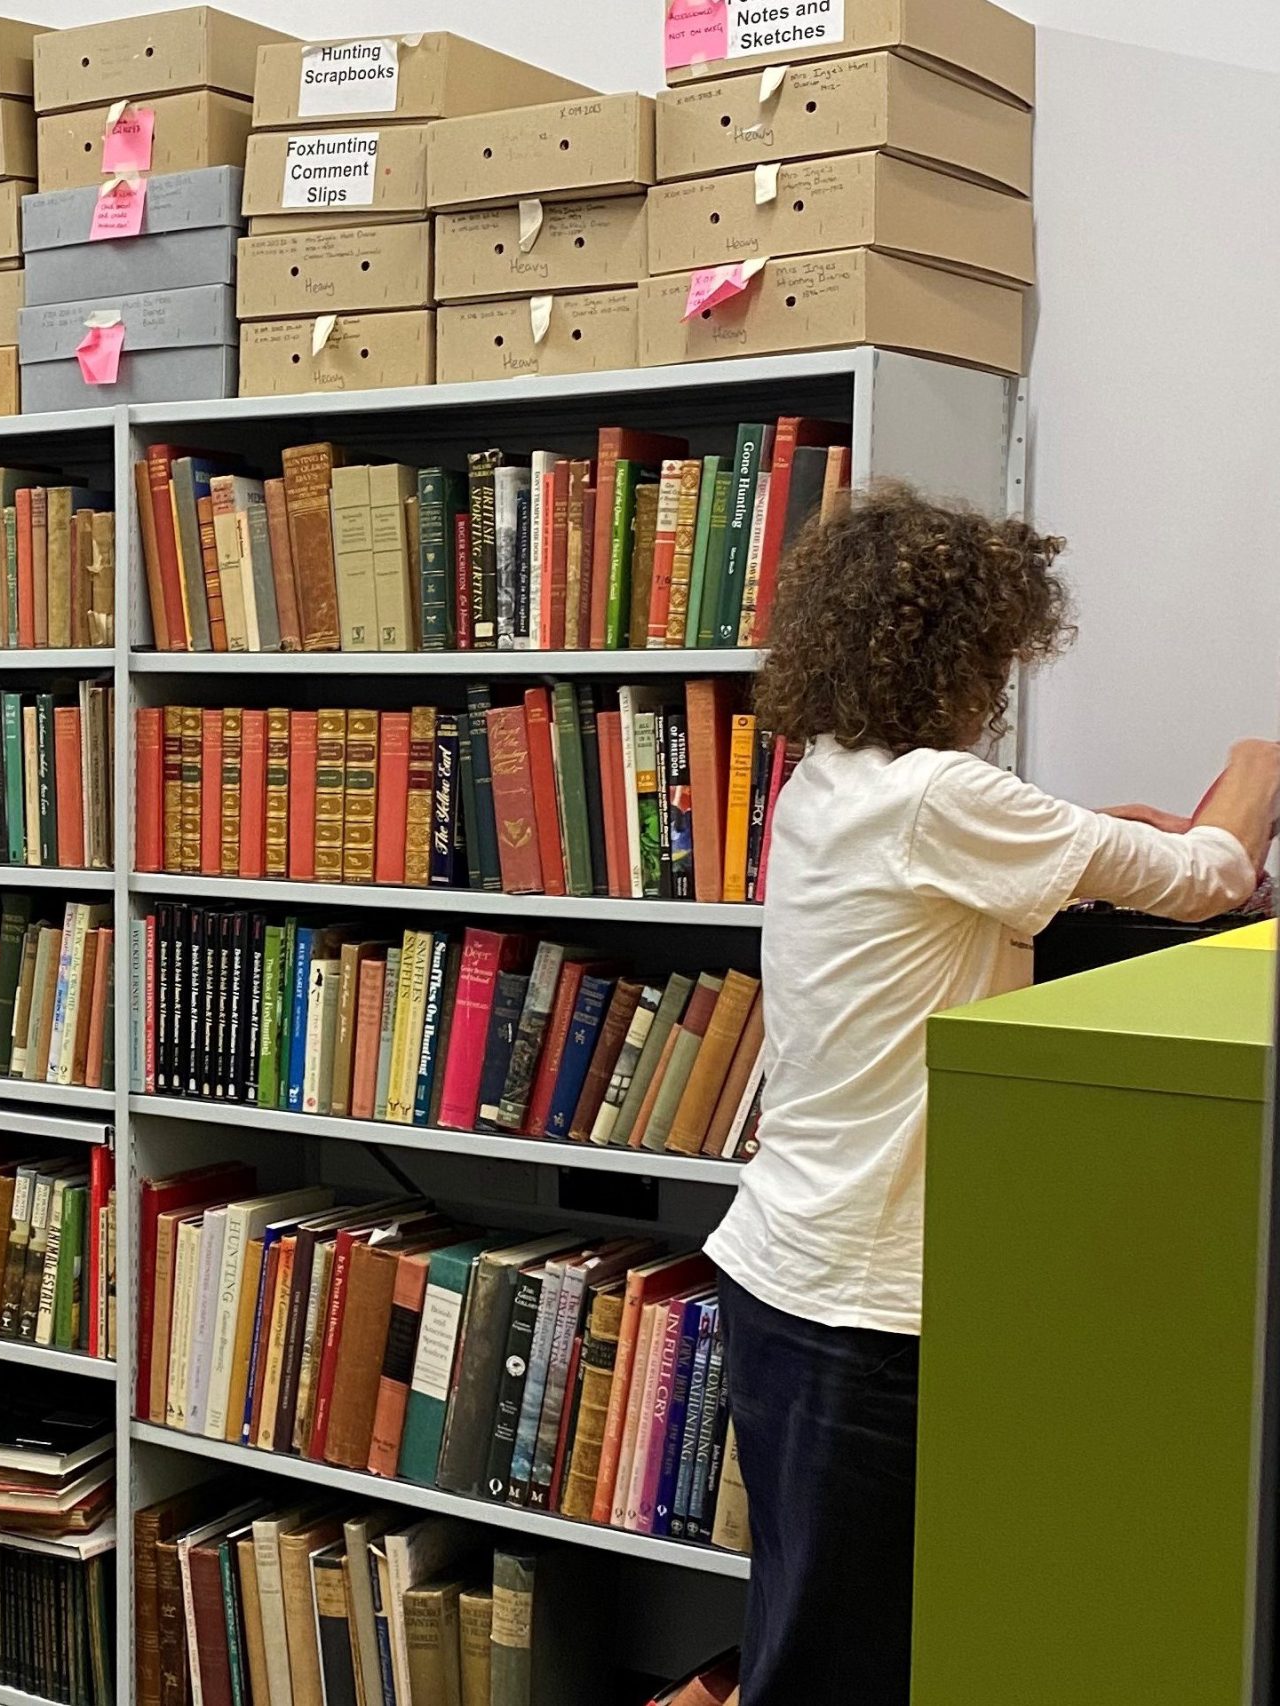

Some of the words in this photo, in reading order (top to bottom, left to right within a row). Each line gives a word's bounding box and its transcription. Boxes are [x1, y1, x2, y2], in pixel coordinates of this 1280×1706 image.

[737, 7, 789, 26] Notes
[796, 0, 830, 16] and
[322, 44, 381, 62] Hunting
[740, 25, 825, 49] Sketches
[305, 65, 394, 86] Scrapbooks
[287, 137, 378, 158] Foxhunting
[291, 161, 369, 180] Comment
[307, 187, 347, 205] Slips
[740, 441, 754, 474] Gone
[472, 487, 483, 556] SPORTING
[483, 486, 494, 545] BRITISH
[732, 478, 750, 528] Hunting
[472, 559, 483, 620] ARTISTS
[671, 726, 677, 736] OF
[438, 745, 452, 778] Earl
[671, 738, 679, 777] FREEDOM
[436, 778, 451, 823] Yellow
[435, 827, 448, 855] The
[401, 935, 416, 999] SNAFFLES
[412, 939, 427, 1002] SNAFFLES
[428, 940, 446, 1002] Snaffles
[463, 948, 492, 960] Deer
[426, 1003, 437, 1022] On
[418, 1024, 435, 1076] Hunting
[46, 1225, 61, 1271] ANIMAL
[222, 1218, 241, 1302] HUNTING
[40, 1274, 57, 1315] ESTATE
[424, 1325, 454, 1340] American
[666, 1313, 680, 1333] IN
[423, 1335, 450, 1352] Sporting
[659, 1338, 676, 1383] FULL
[654, 1386, 669, 1423] CRY
[681, 1363, 704, 1463] FOXHUNTING
[696, 1364, 719, 1464] FOXHUNTING
